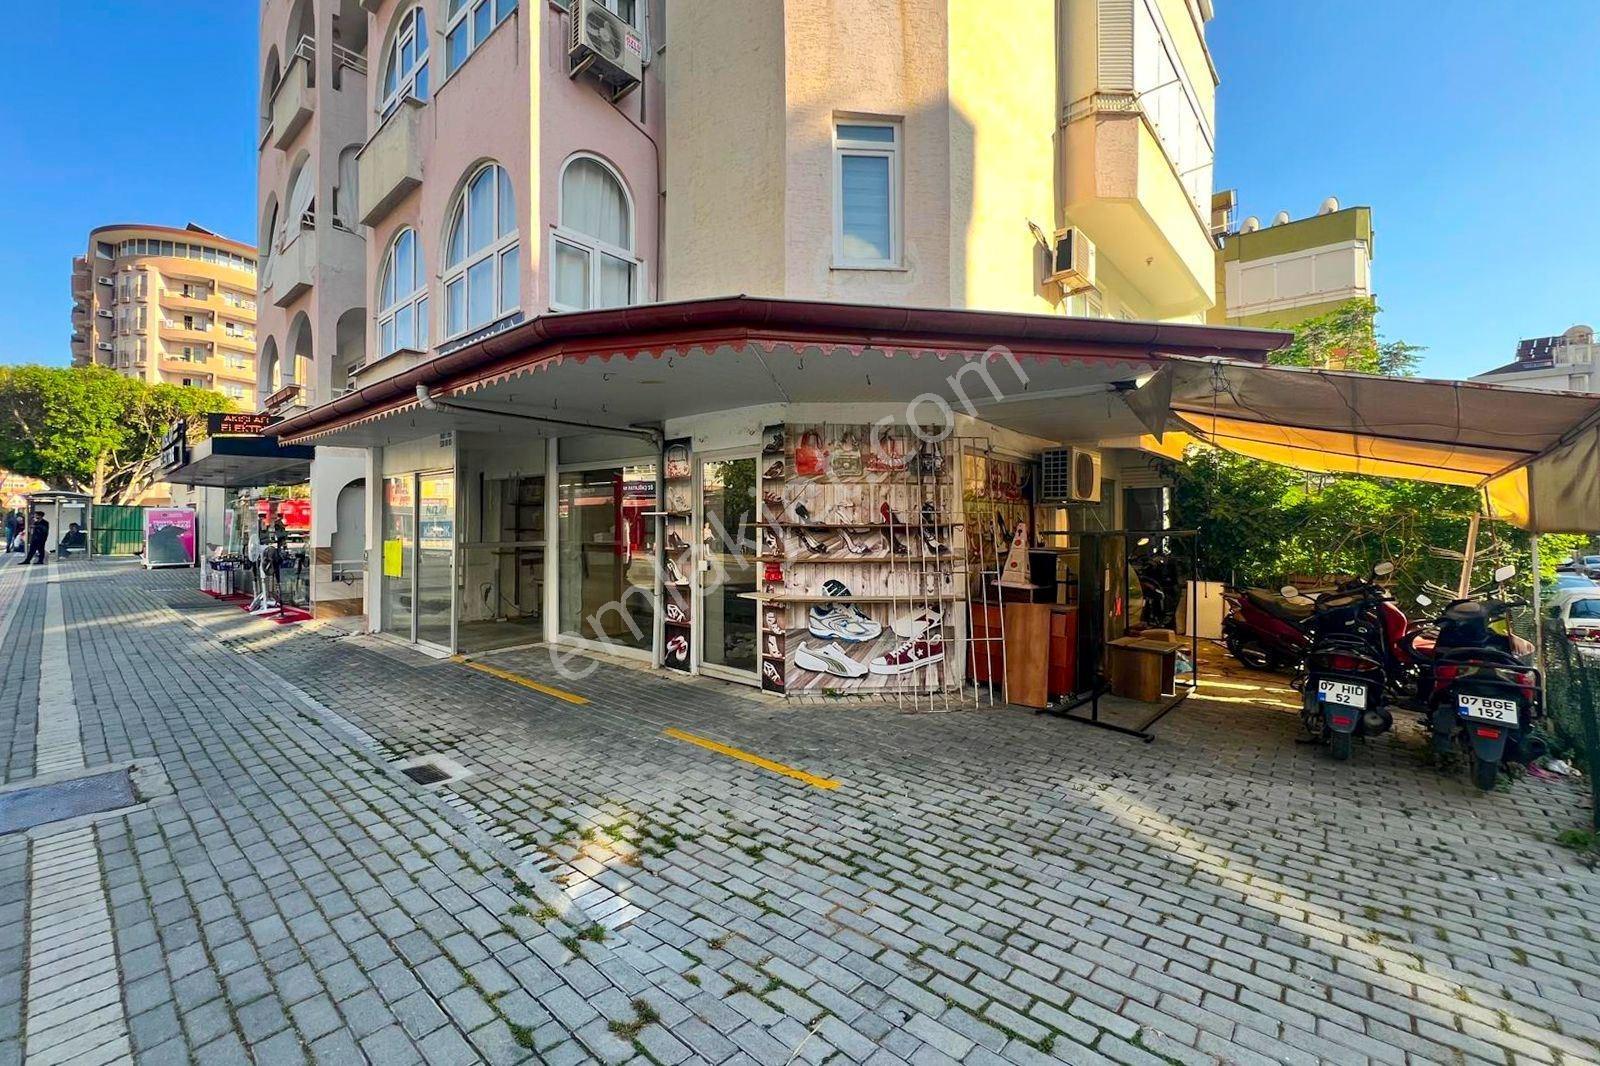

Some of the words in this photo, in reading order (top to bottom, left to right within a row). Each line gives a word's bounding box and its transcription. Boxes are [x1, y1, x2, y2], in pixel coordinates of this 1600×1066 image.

[1320, 682, 1335, 691] 07
[1342, 685, 1364, 696] HID
[1336, 693, 1351, 704] 52
[1461, 696, 1479, 705] 07
[1482, 699, 1515, 712] BGE
[1478, 708, 1504, 720] 152
